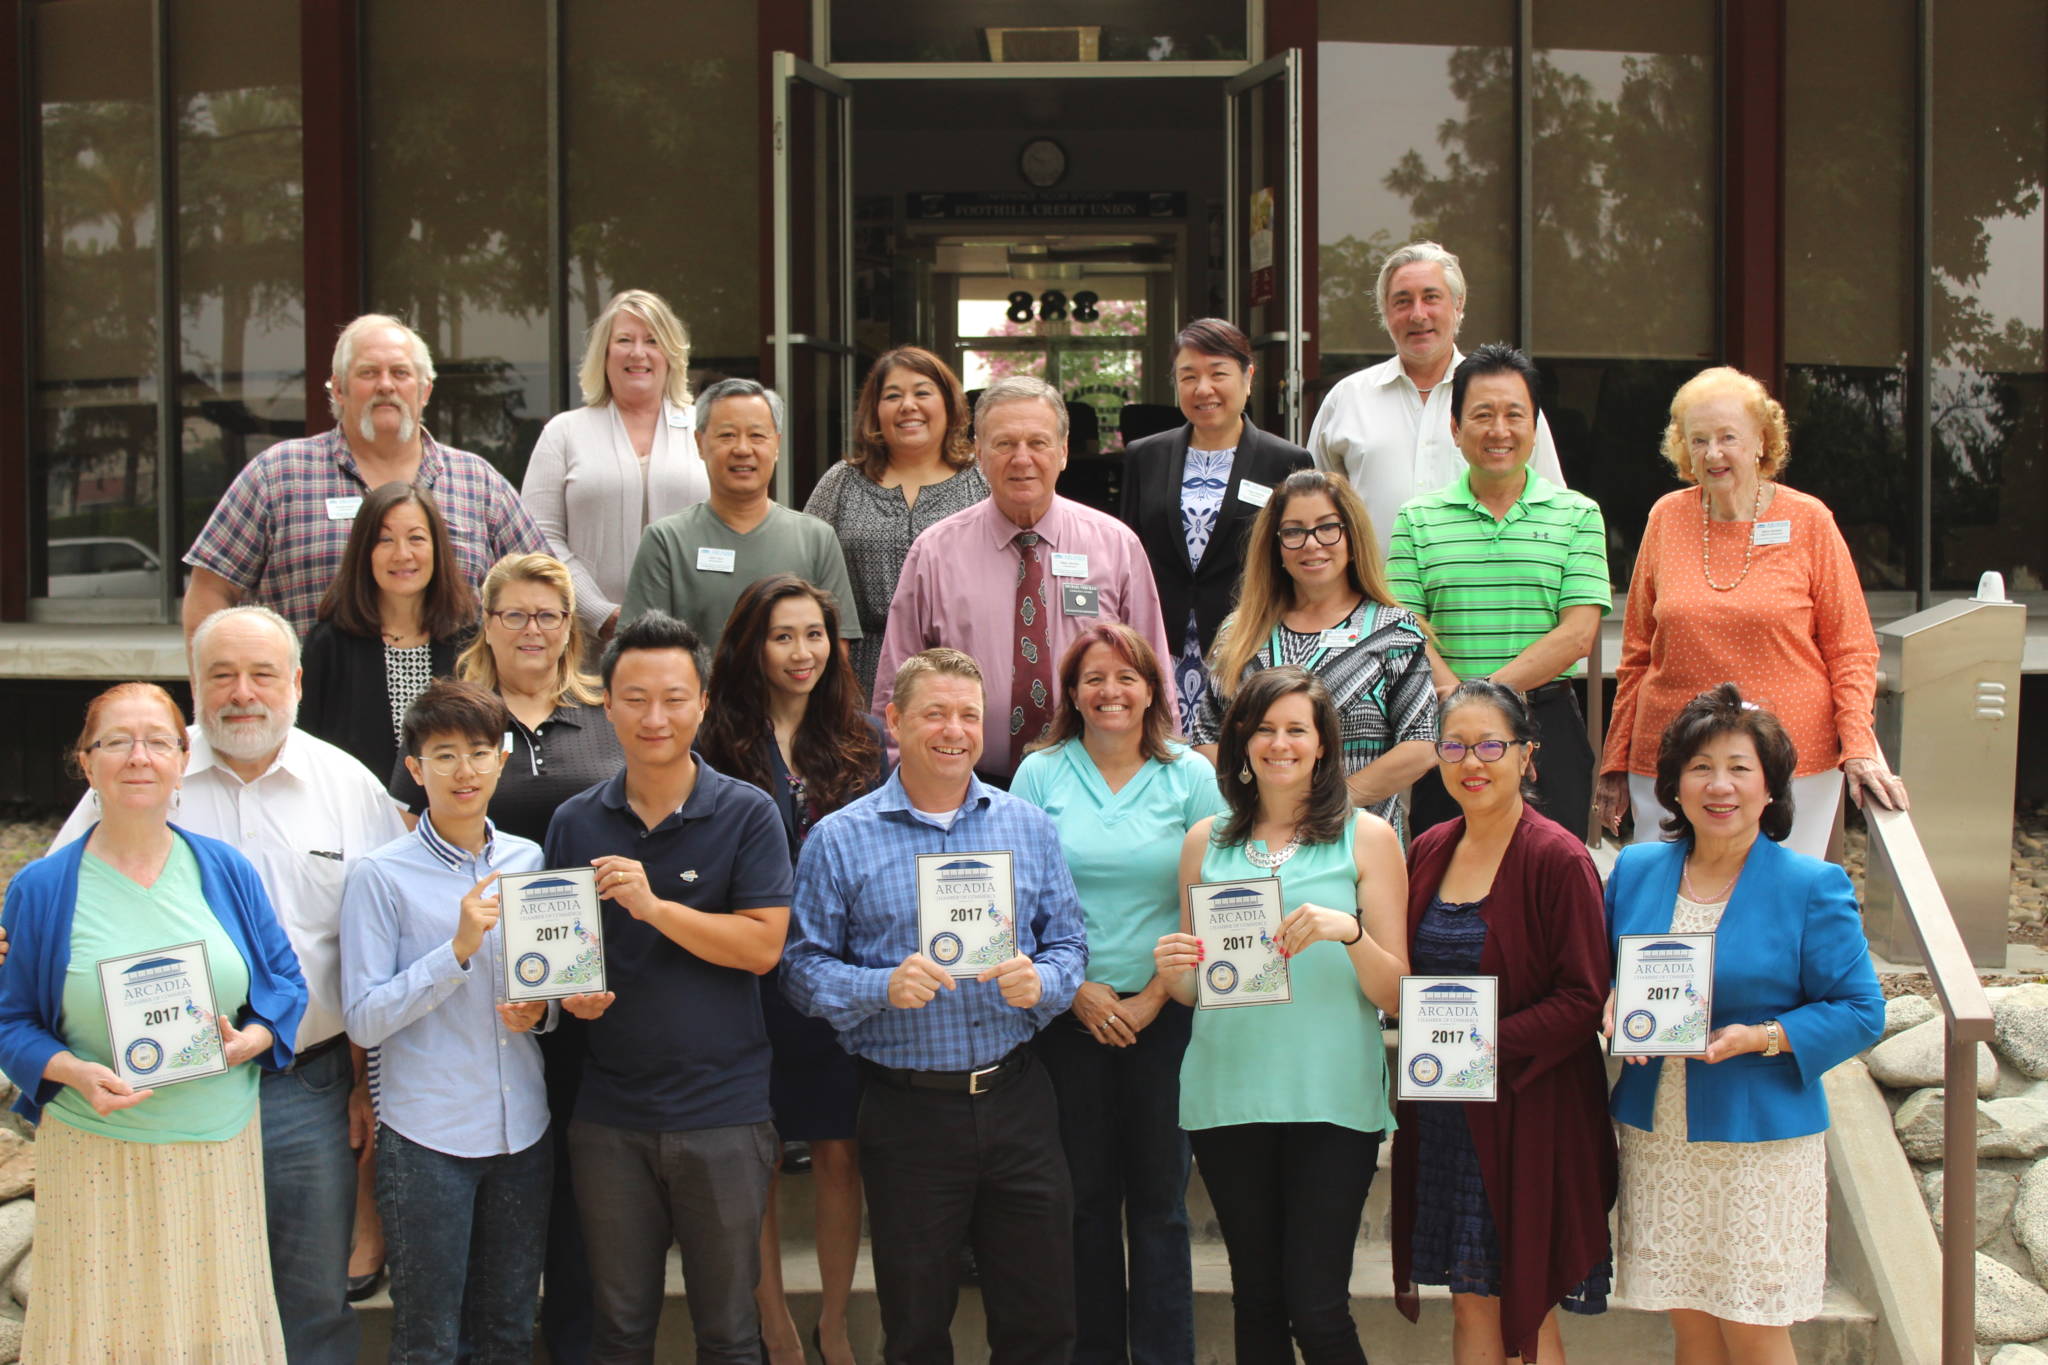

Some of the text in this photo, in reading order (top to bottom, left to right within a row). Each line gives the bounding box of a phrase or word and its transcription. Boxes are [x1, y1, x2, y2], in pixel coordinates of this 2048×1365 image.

[954, 202, 1137, 217] FOOTHILL CREDIT UNION
[1007, 290, 1099, 323] 888
[936, 882, 996, 895] ARCADIA
[520, 899, 581, 915] ARCADIA
[950, 908, 983, 922] 2017
[1209, 909, 1266, 924] ARCADIA
[536, 926, 569, 942] 2017
[1223, 935, 1253, 951] 2017
[1635, 963, 1695, 974] ARCADIA
[124, 977, 191, 1001] ARCADIA
[1647, 987, 1680, 1001] 2017
[144, 1006, 180, 1026] 2017
[1418, 1006, 1479, 1017] ARCADIA
[1431, 1030, 1465, 1044] 2017
